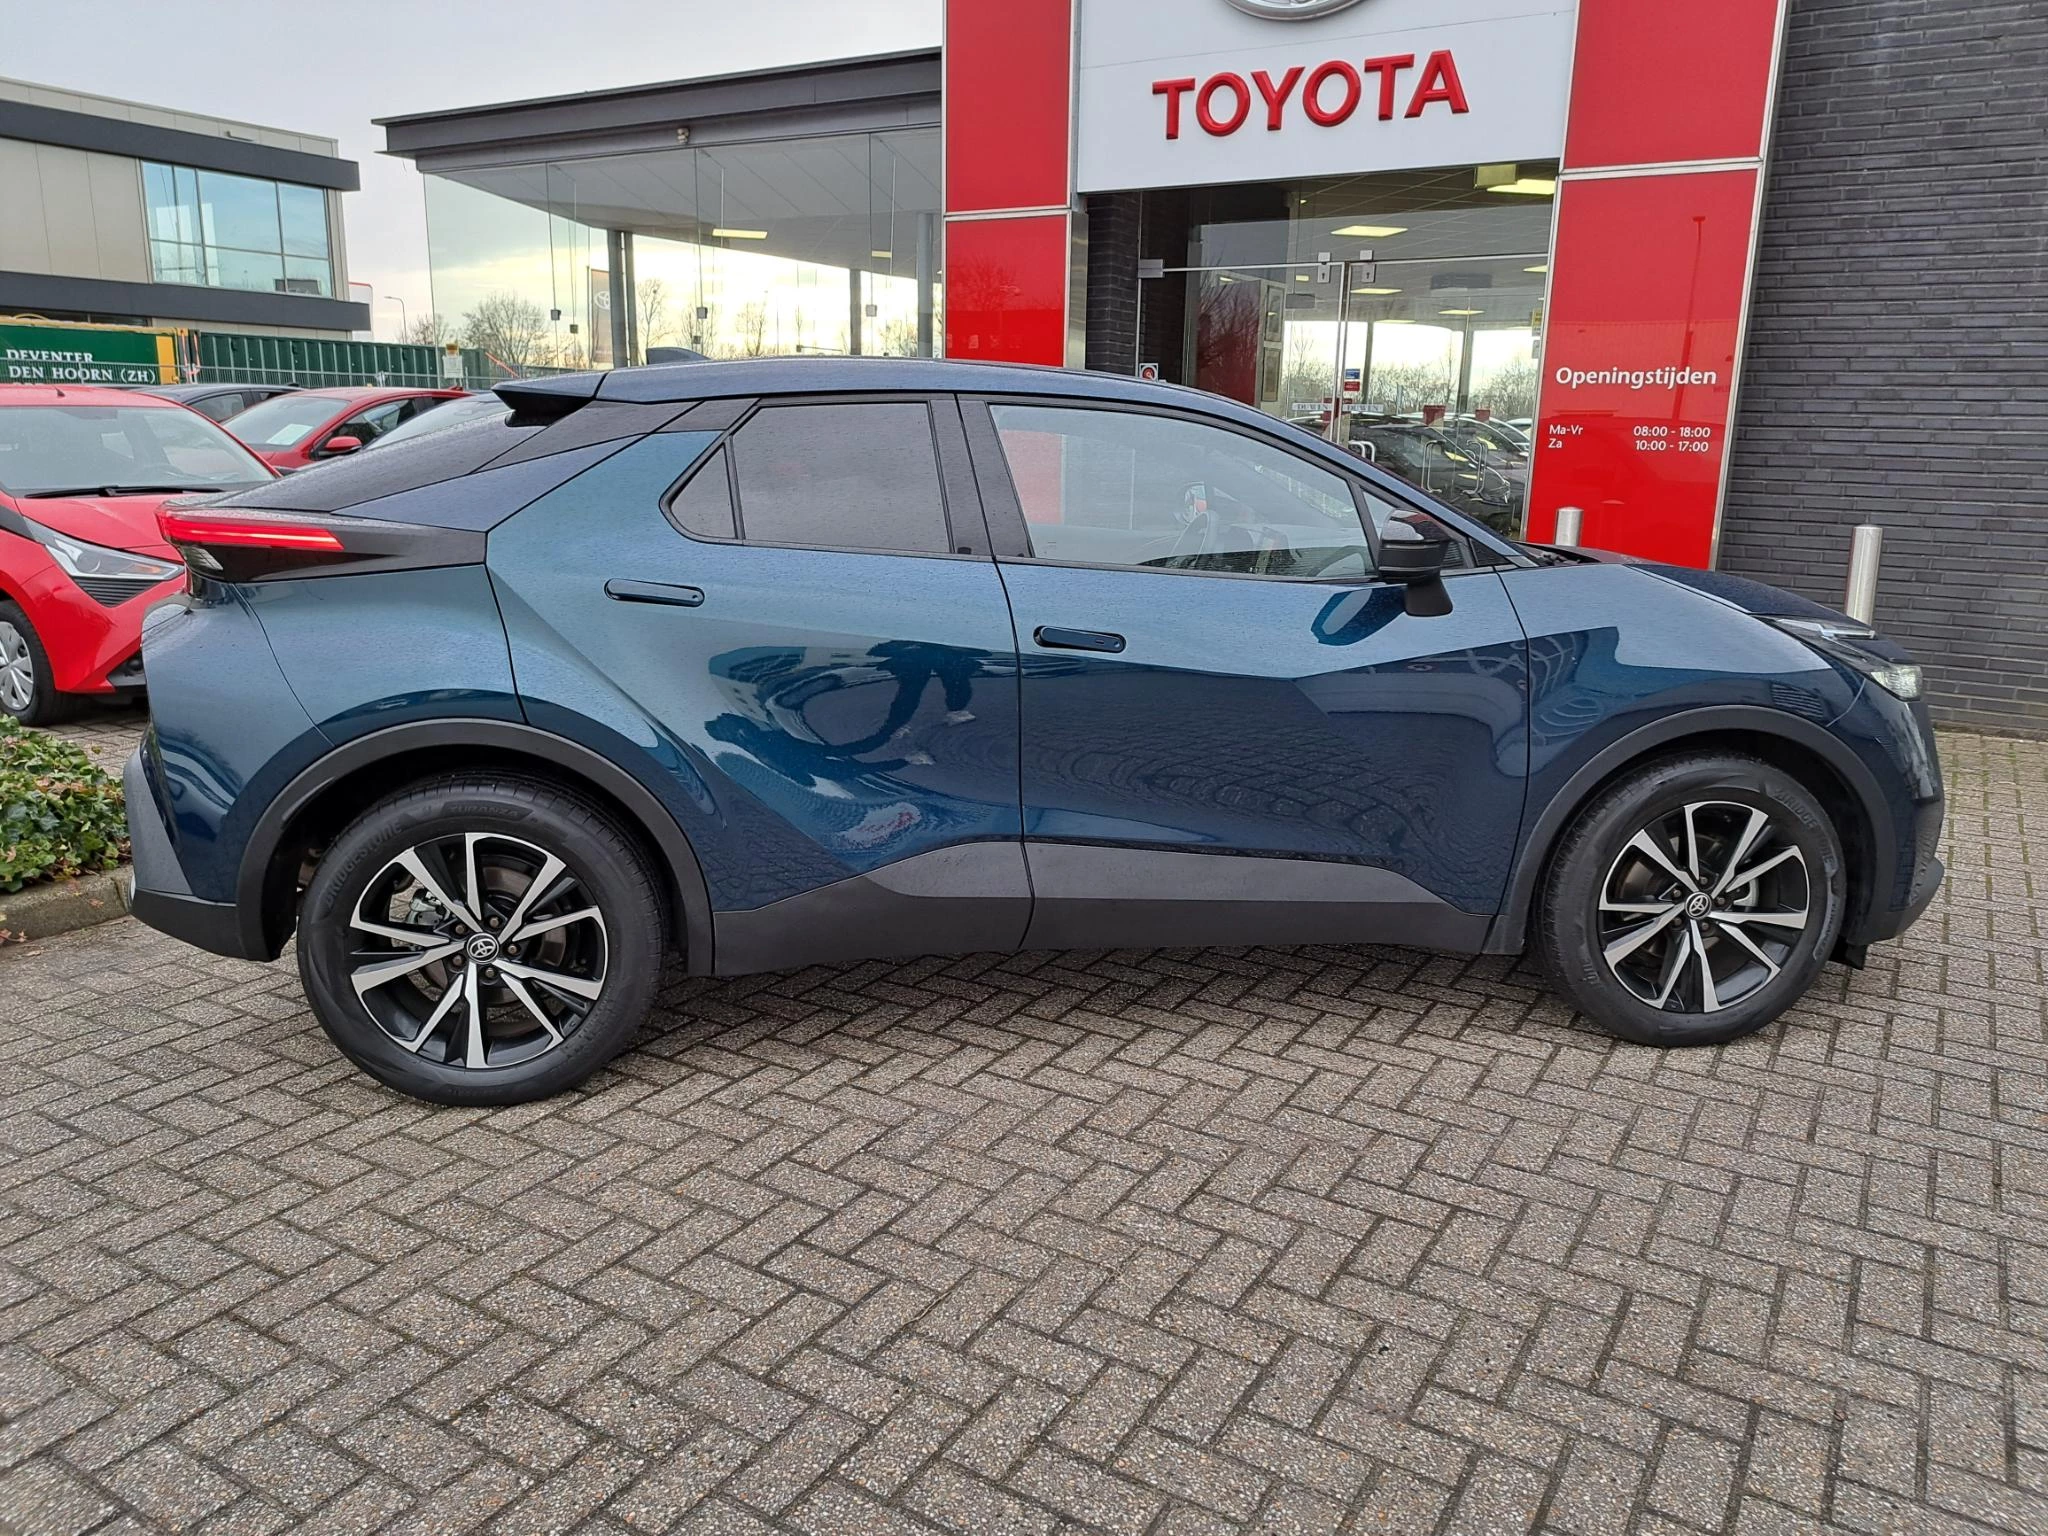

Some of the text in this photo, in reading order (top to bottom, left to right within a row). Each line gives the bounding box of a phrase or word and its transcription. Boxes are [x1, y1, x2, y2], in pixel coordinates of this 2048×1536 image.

[1152, 49, 1469, 140] TOYOTA
[6, 348, 94, 363] DEVENTER
[8, 365, 156, 384] DEN HOORN (ZH)
[1555, 366, 1717, 389] Openingstijden
[1549, 424, 1583, 435] Ma-Vr
[1633, 426, 1668, 437] 08:00
[1679, 427, 1711, 438] 18:00
[1548, 438, 1563, 449] Za
[1635, 440, 1667, 451] 10:00
[1678, 441, 1709, 452] 17:00
